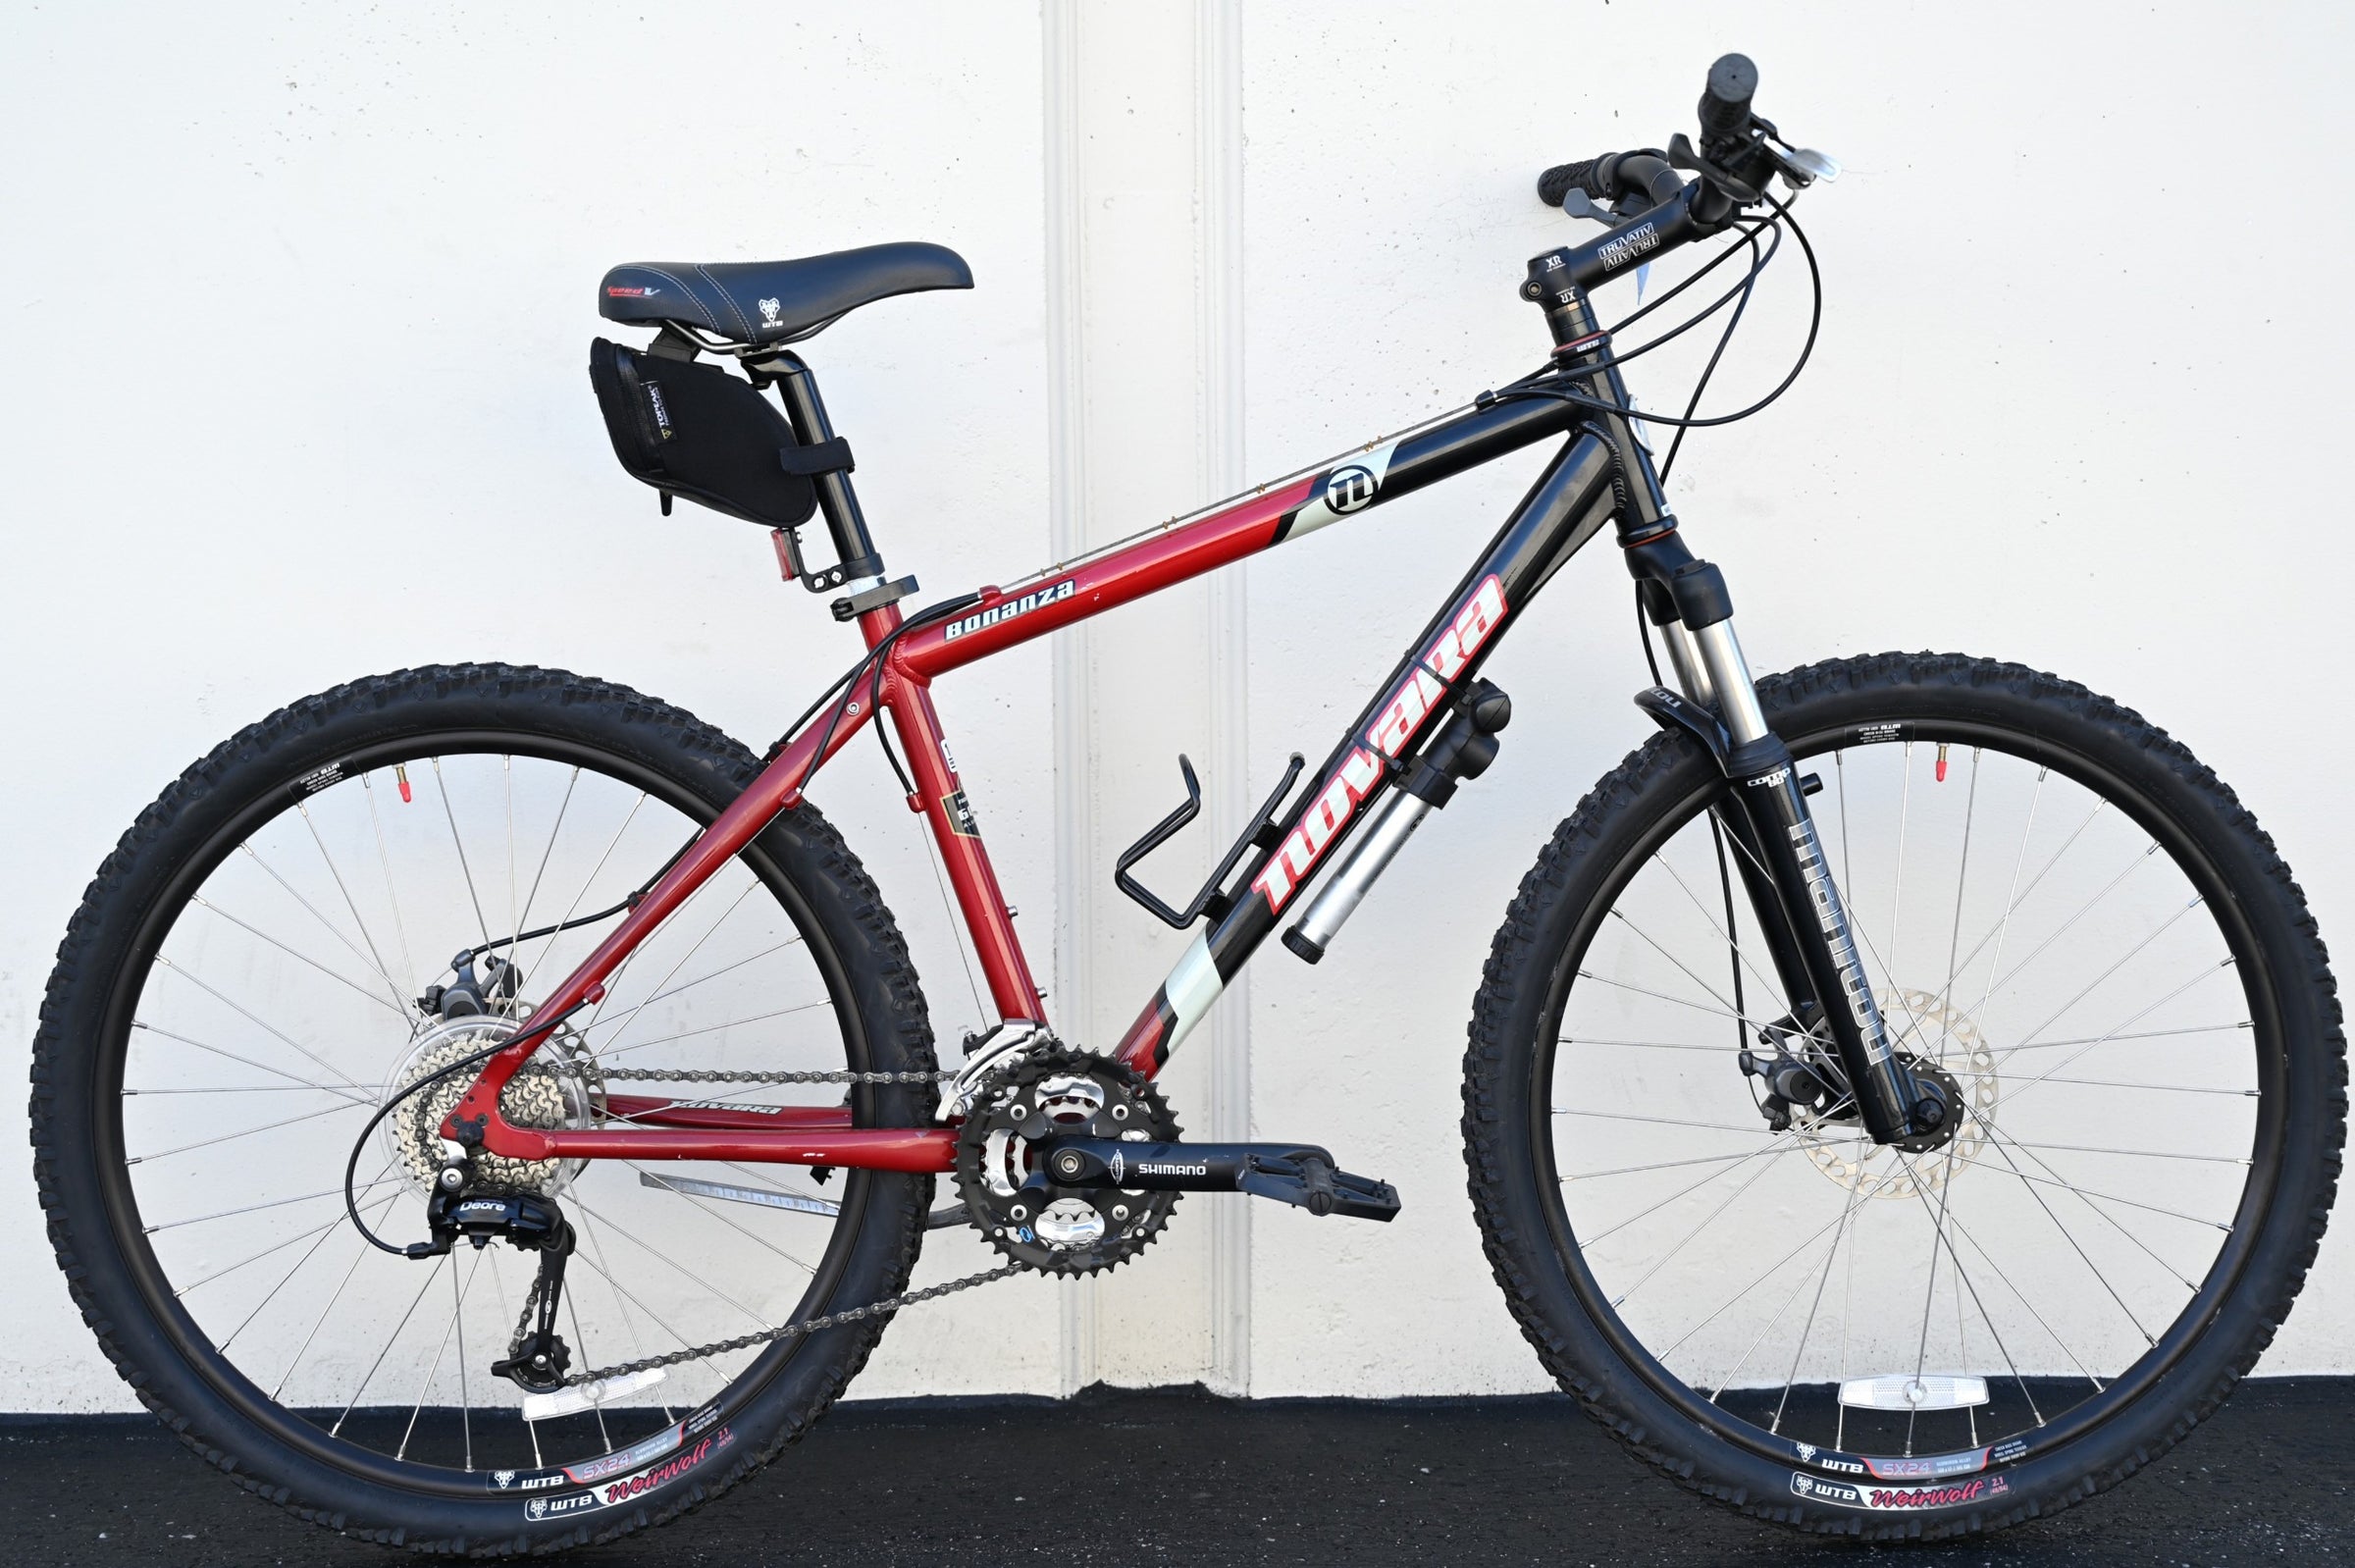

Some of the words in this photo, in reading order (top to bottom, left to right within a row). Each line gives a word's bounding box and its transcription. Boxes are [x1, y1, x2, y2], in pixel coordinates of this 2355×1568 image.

[1599, 225, 1652, 258] TRUVATIV
[1605, 235, 1658, 270] TRUVATIV
[1546, 255, 1562, 268] XR
[1560, 289, 1576, 303] XR
[1138, 1164, 1207, 1176] SHIMANO
[459, 1201, 506, 1211] Deore
[521, 1475, 564, 1490] WTB
[582, 1452, 631, 1480] SX24
[1821, 1458, 1863, 1474] WTB
[1882, 1461, 1931, 1476] SX24
[1815, 1484, 1857, 1500] WTB
[550, 1494, 593, 1511] WTB
